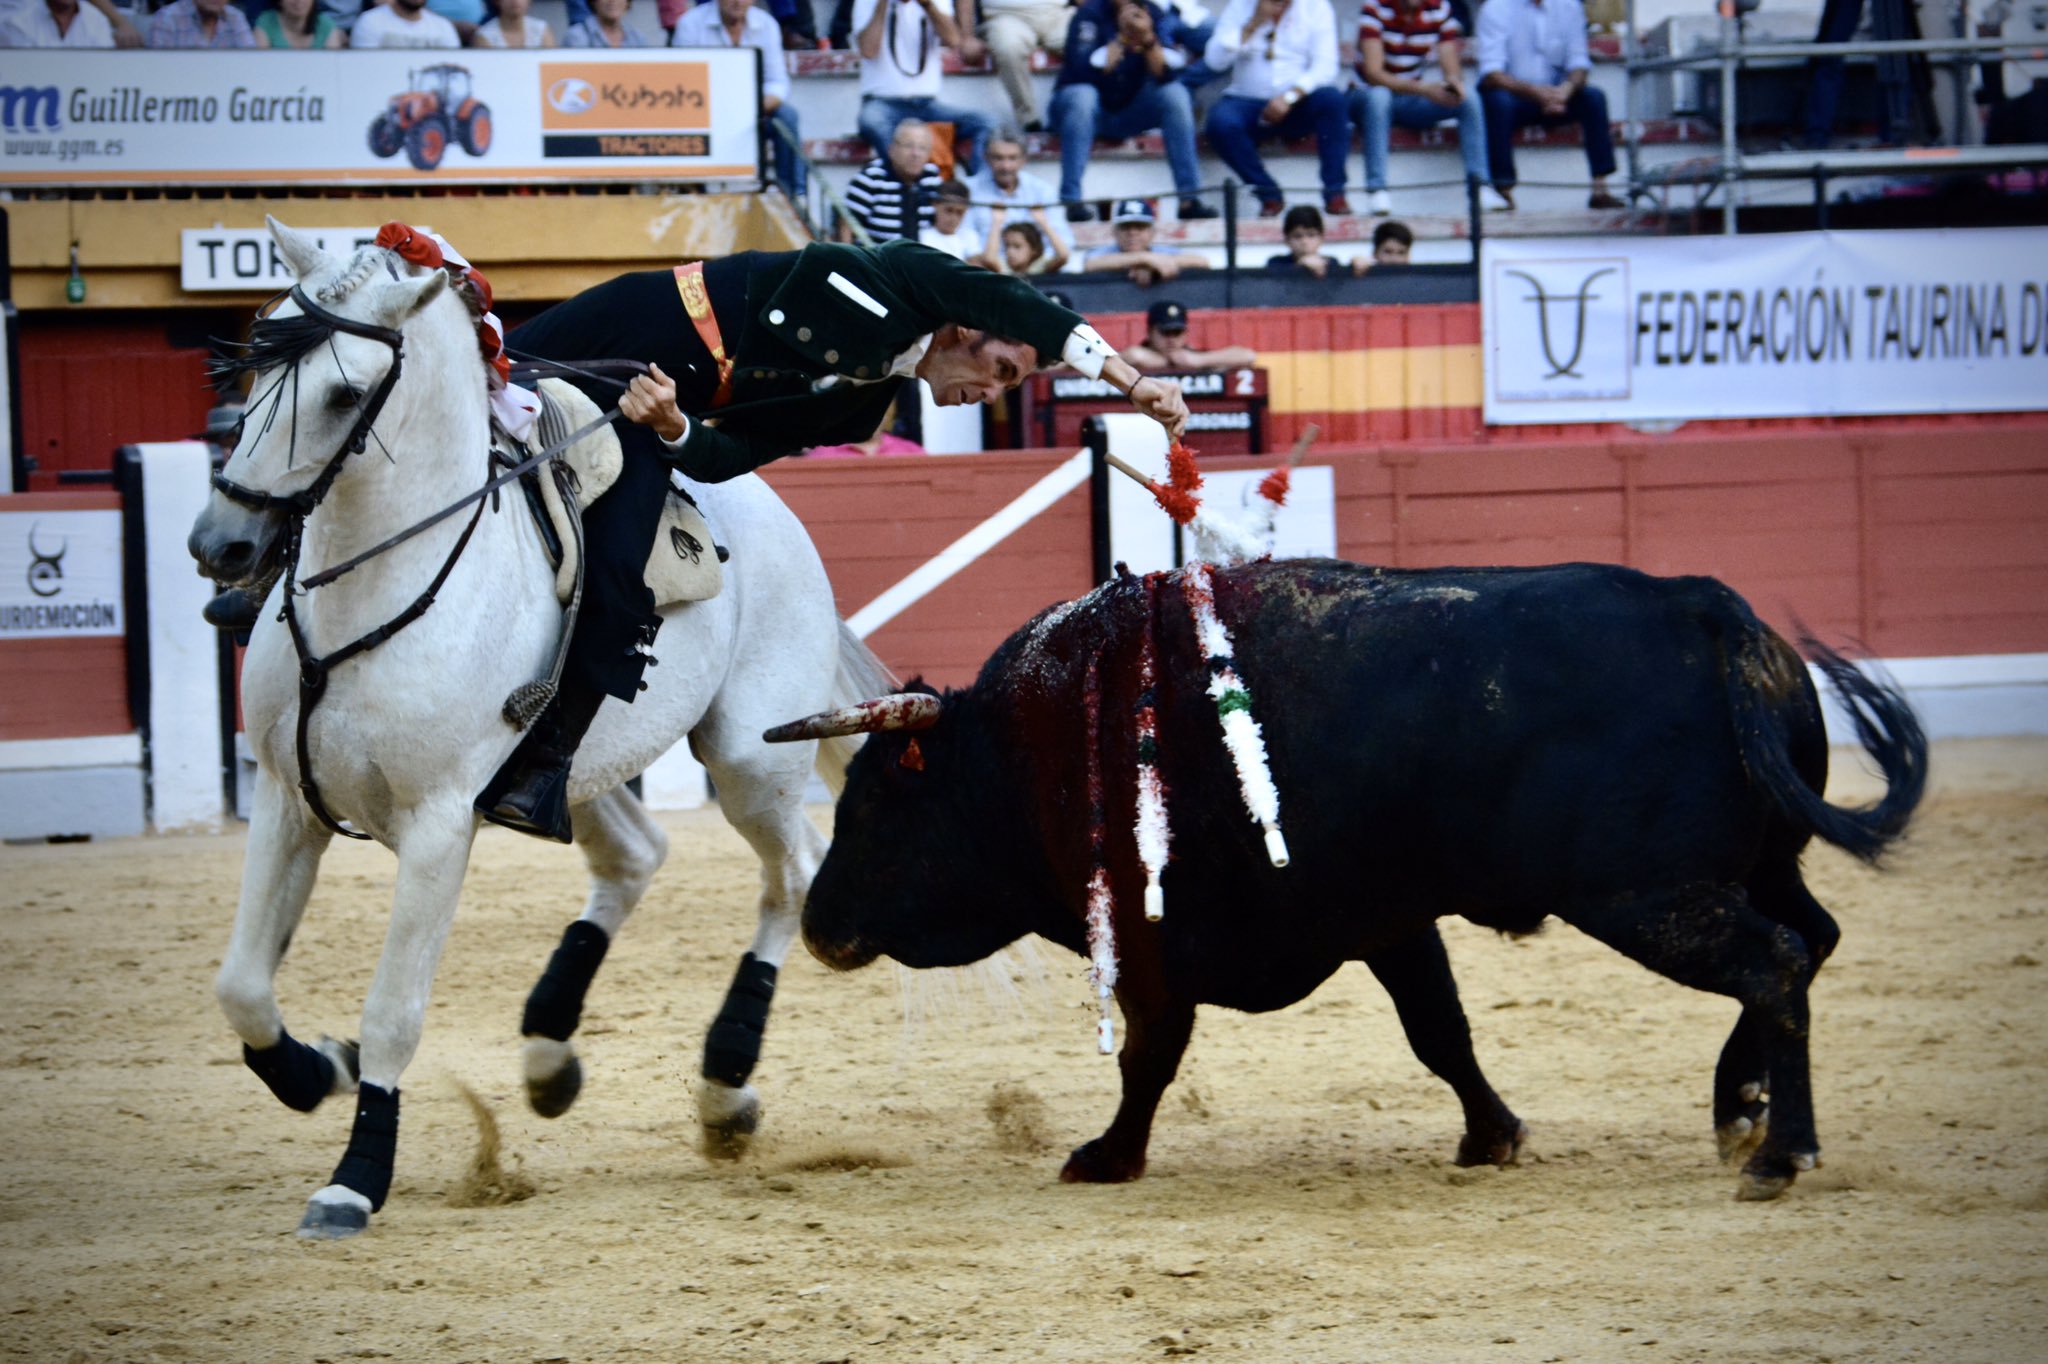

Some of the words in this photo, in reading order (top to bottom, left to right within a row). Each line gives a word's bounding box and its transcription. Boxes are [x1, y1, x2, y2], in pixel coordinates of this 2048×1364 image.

[68, 87, 218, 123] Guillermo
[230, 86, 325, 123] García
[601, 83, 704, 109] Kubota
[4, 139, 124, 162] www.ggm.es
[599, 136, 705, 155] TRACTORES
[1633, 267, 1854, 366] FEDERACIÓN
[1866, 282, 2010, 361] TAURINA
[2020, 281, 2048, 358] D
[1235, 369, 1255, 395] 2
